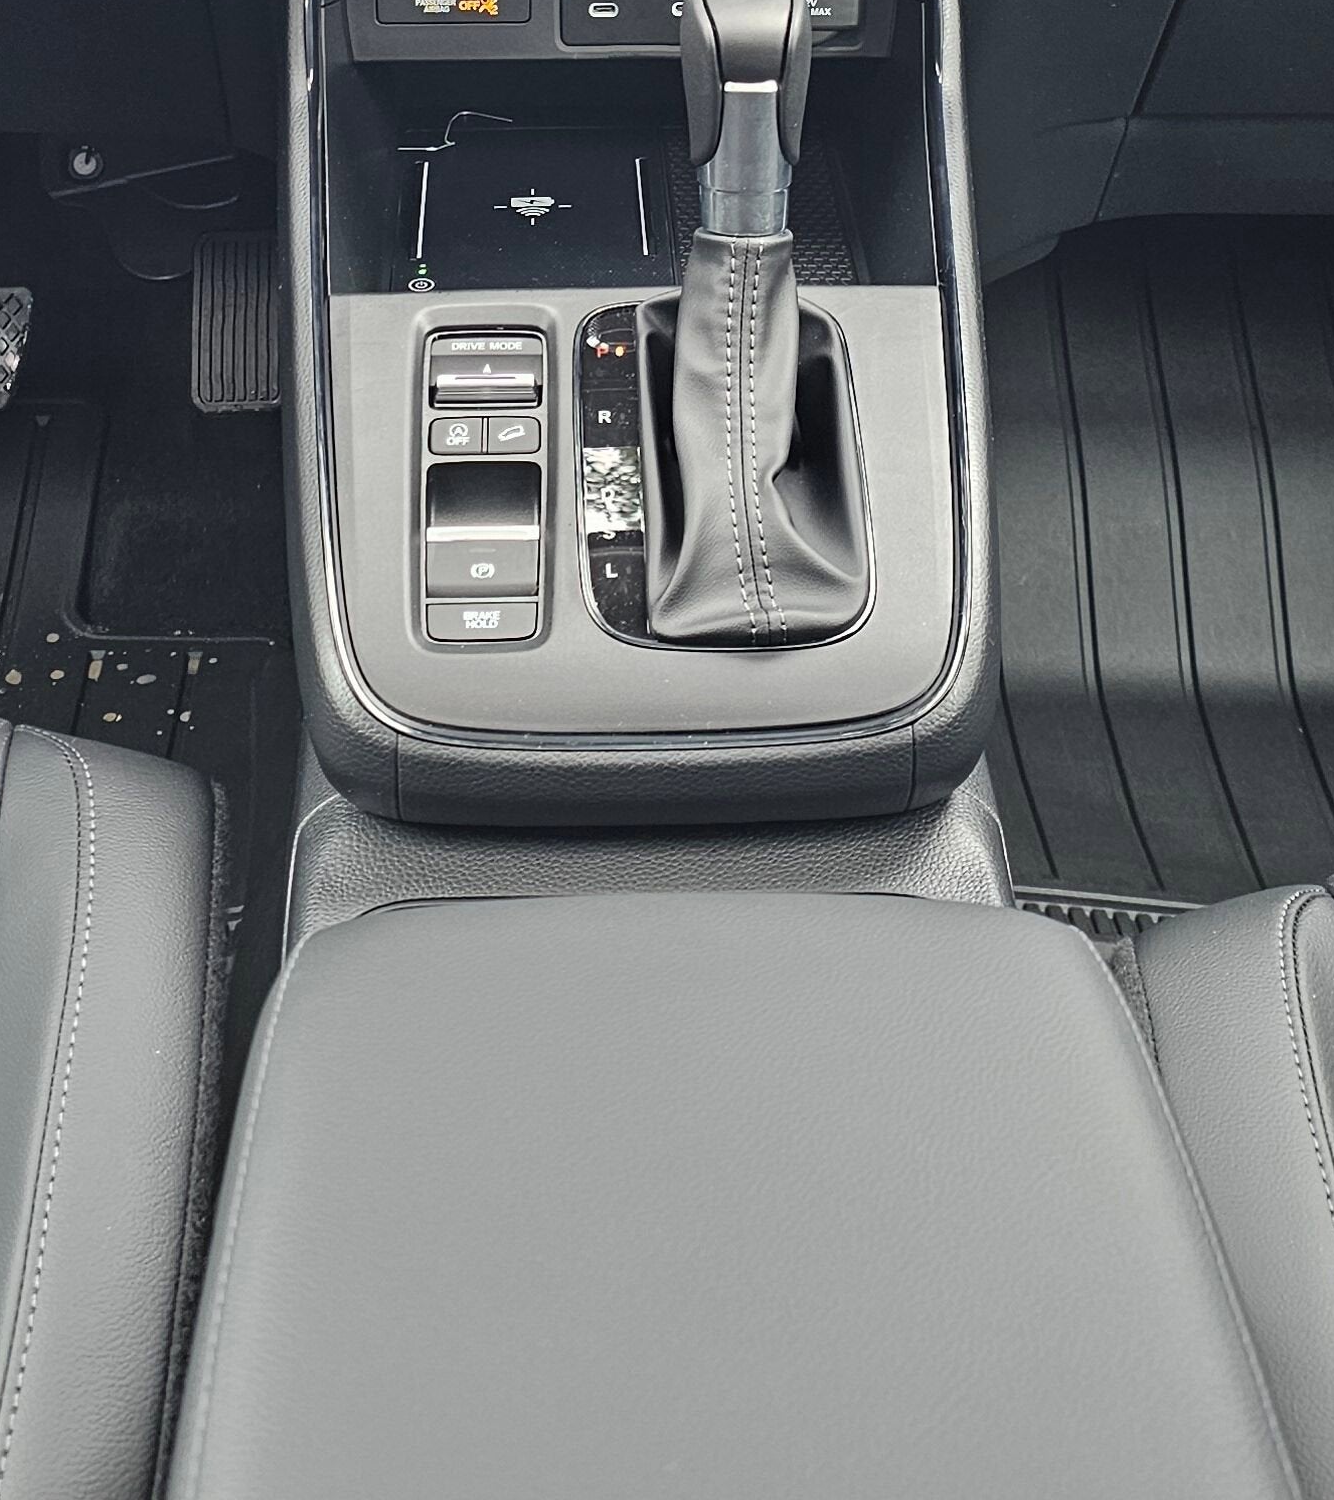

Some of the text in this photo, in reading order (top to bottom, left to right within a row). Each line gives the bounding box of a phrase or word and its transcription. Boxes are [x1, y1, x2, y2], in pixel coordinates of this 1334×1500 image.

[458, 0, 480, 11] OFF
[811, 8, 832, 16] MAX
[451, 341, 523, 351] DRIVE MODE
[598, 411, 612, 424] R
[446, 436, 470, 446] OFF
[605, 563, 618, 579] L
[463, 610, 501, 621] BRAKE
[465, 620, 499, 629] HOLD
